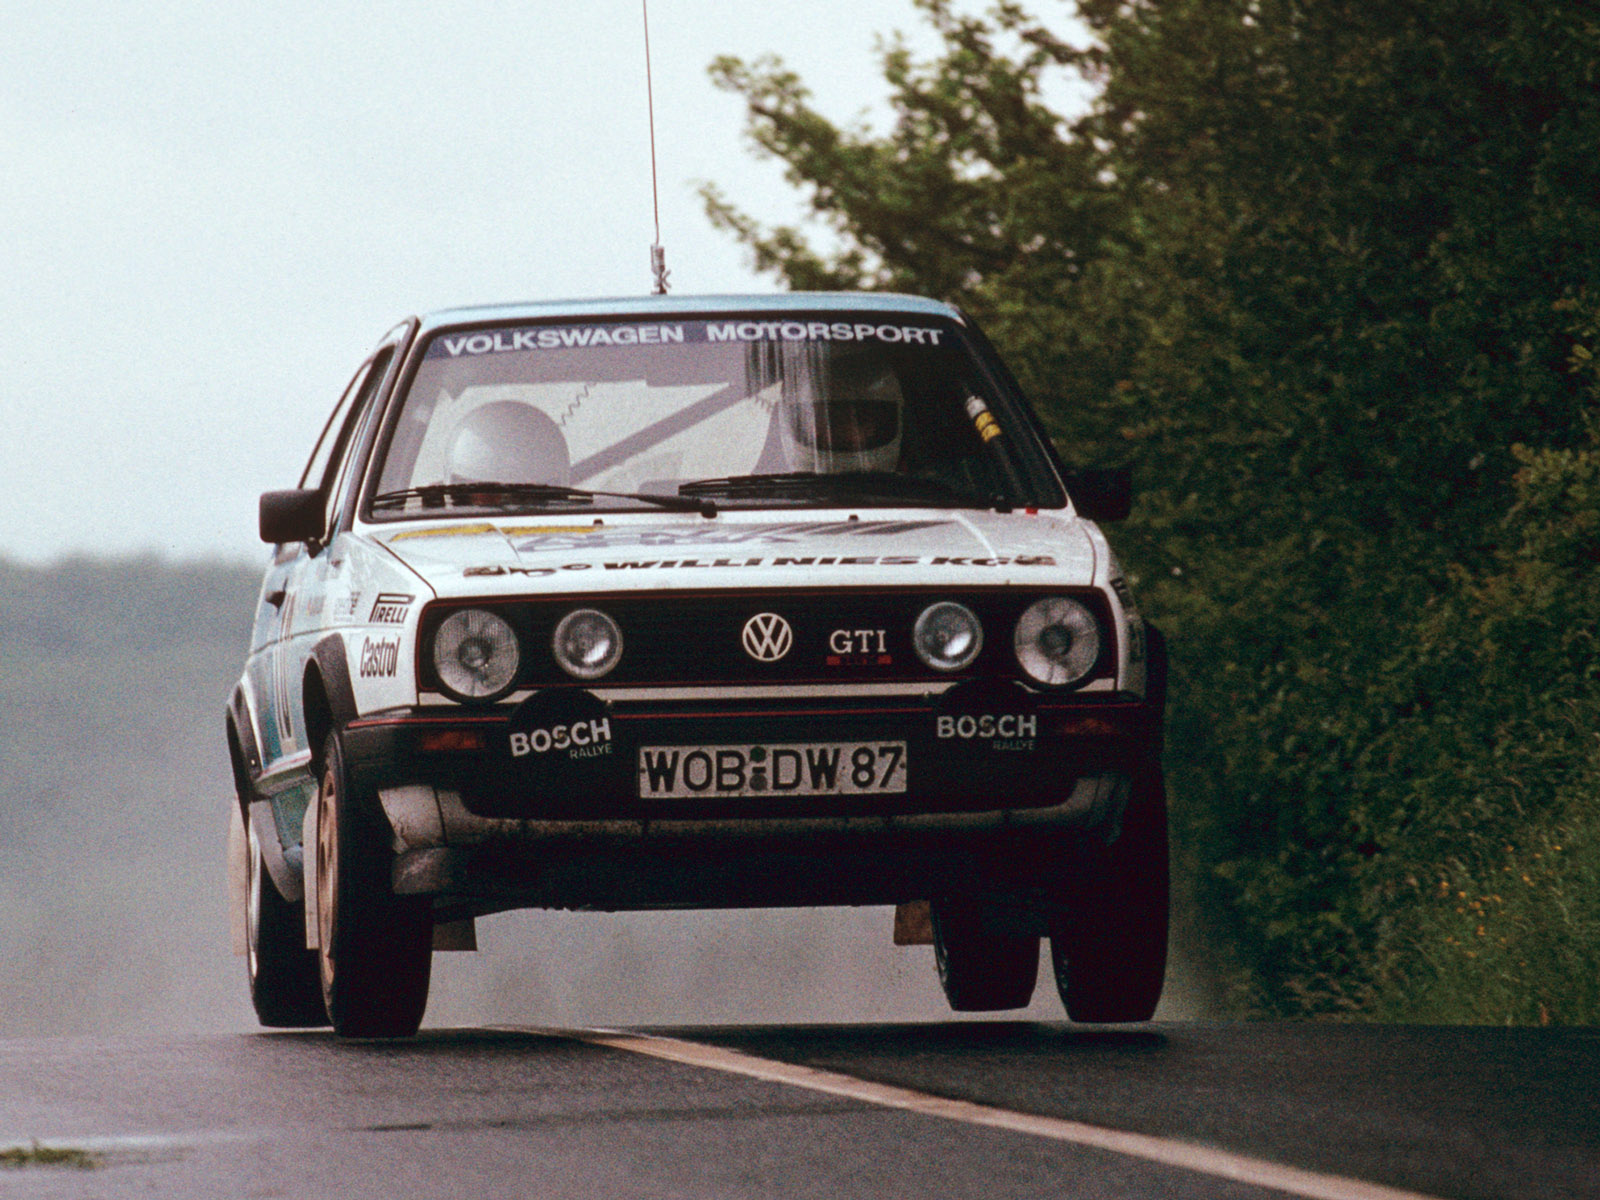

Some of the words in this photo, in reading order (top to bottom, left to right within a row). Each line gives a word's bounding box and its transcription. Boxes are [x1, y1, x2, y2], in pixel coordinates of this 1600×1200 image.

[443, 325, 685, 356] VOLKSWAGEN
[706, 322, 943, 345] MOTORSPORT
[368, 592, 416, 624] PIRELLI
[742, 612, 793, 662] VW
[829, 629, 887, 654] GTI
[360, 636, 401, 678] Castrol
[509, 717, 612, 757] BOSCH
[937, 714, 1036, 738] BOSCH
[569, 743, 613, 760] RALLYE
